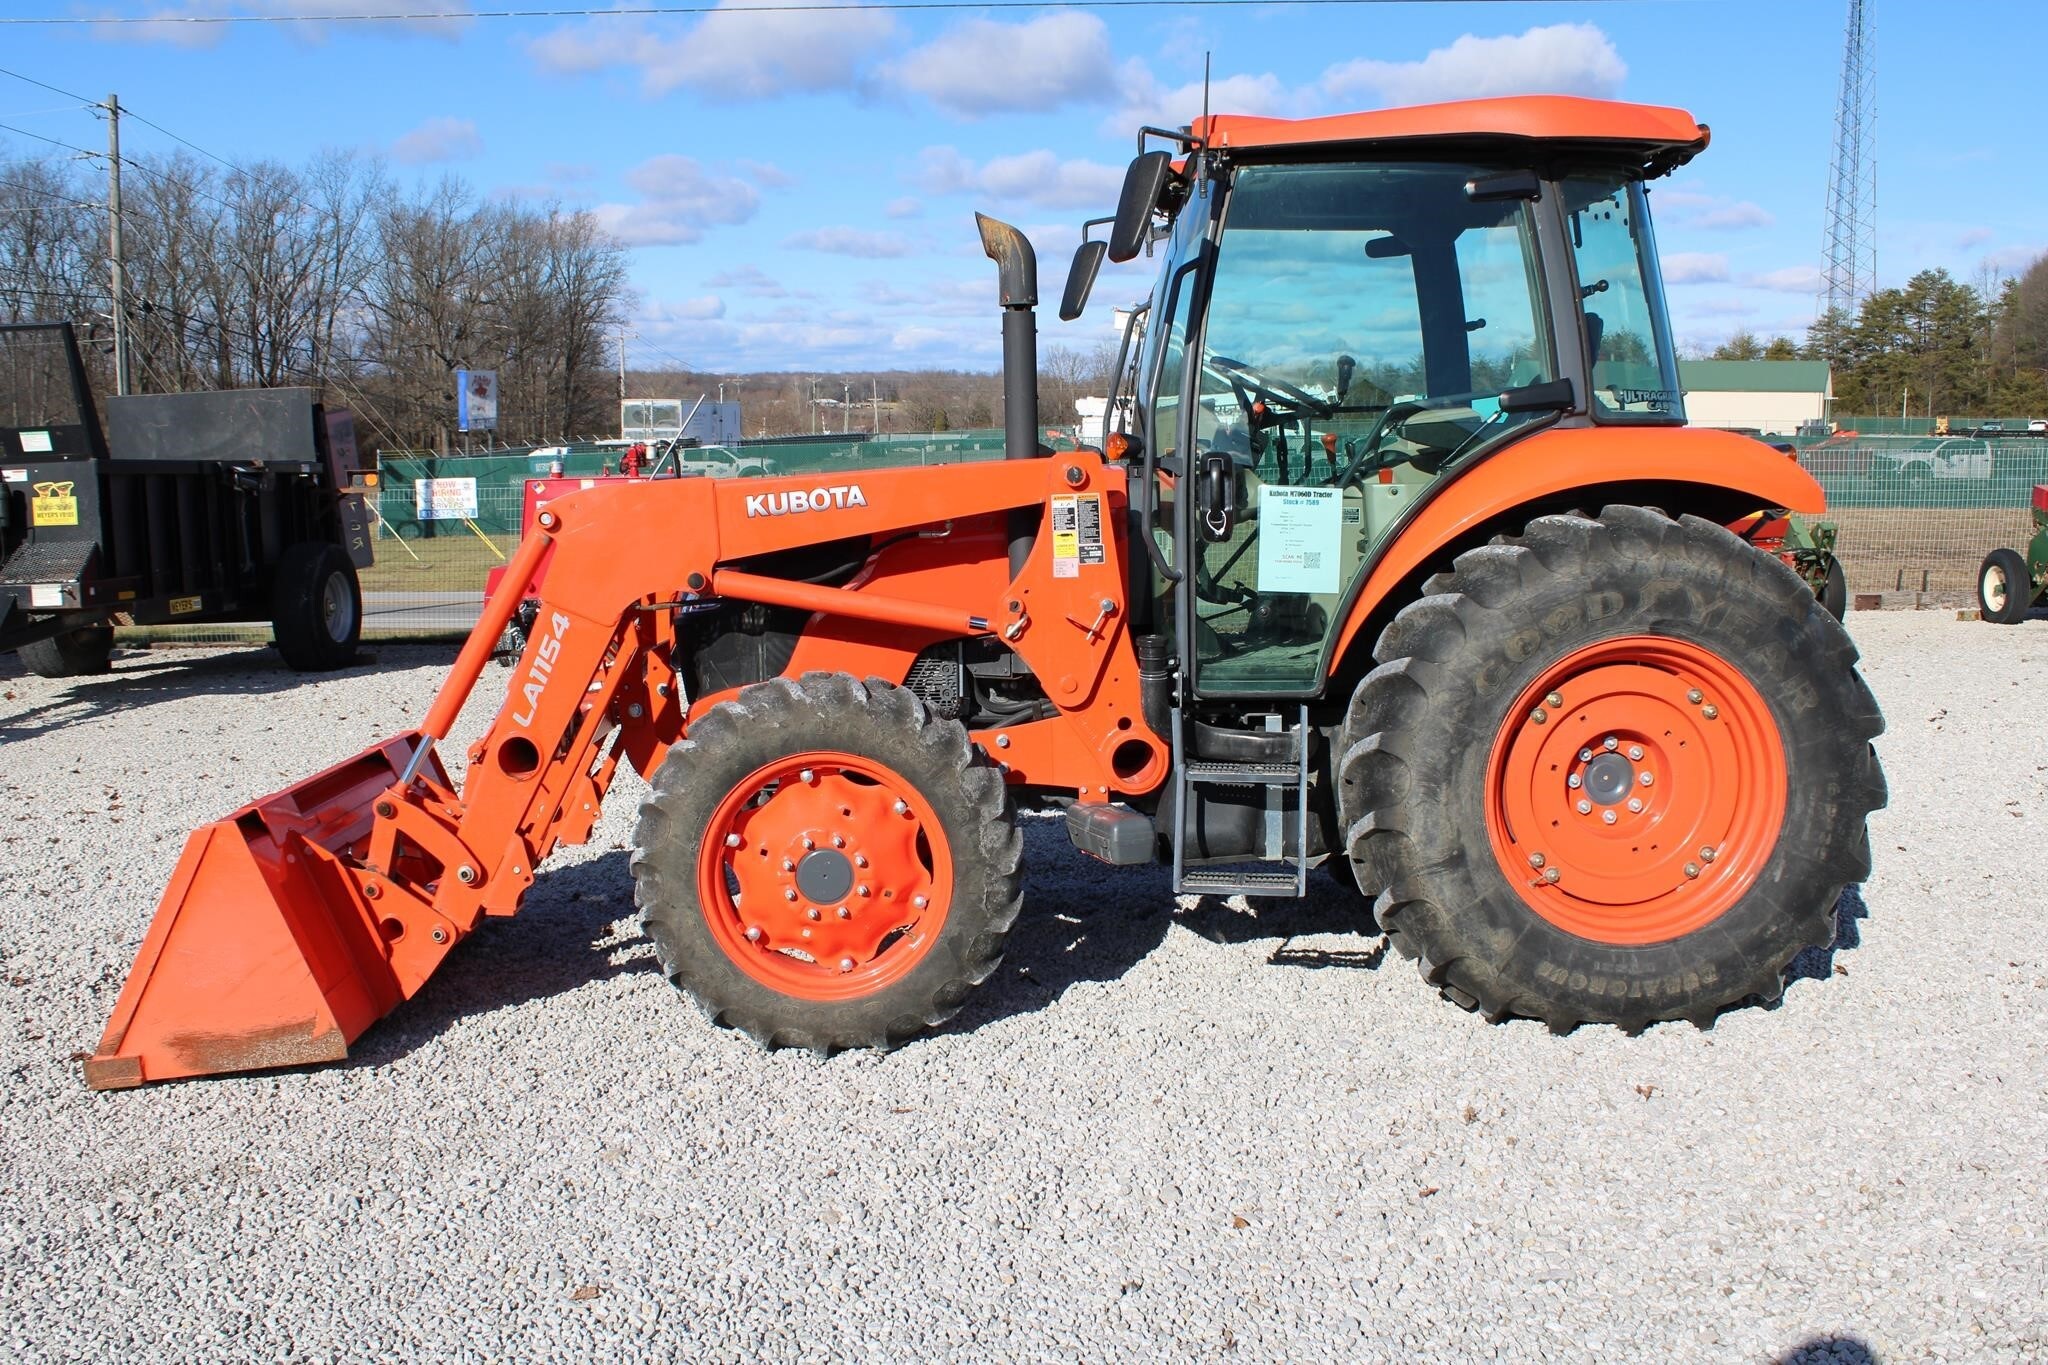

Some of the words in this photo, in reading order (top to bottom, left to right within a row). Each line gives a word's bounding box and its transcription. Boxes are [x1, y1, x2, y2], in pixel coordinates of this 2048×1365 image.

[1648, 401, 1670, 410] CAB
[436, 480, 456, 488] NOW
[431, 488, 462, 497] HIRING
[746, 484, 868, 518] KUBOTA
[512, 611, 570, 728] LA1154
